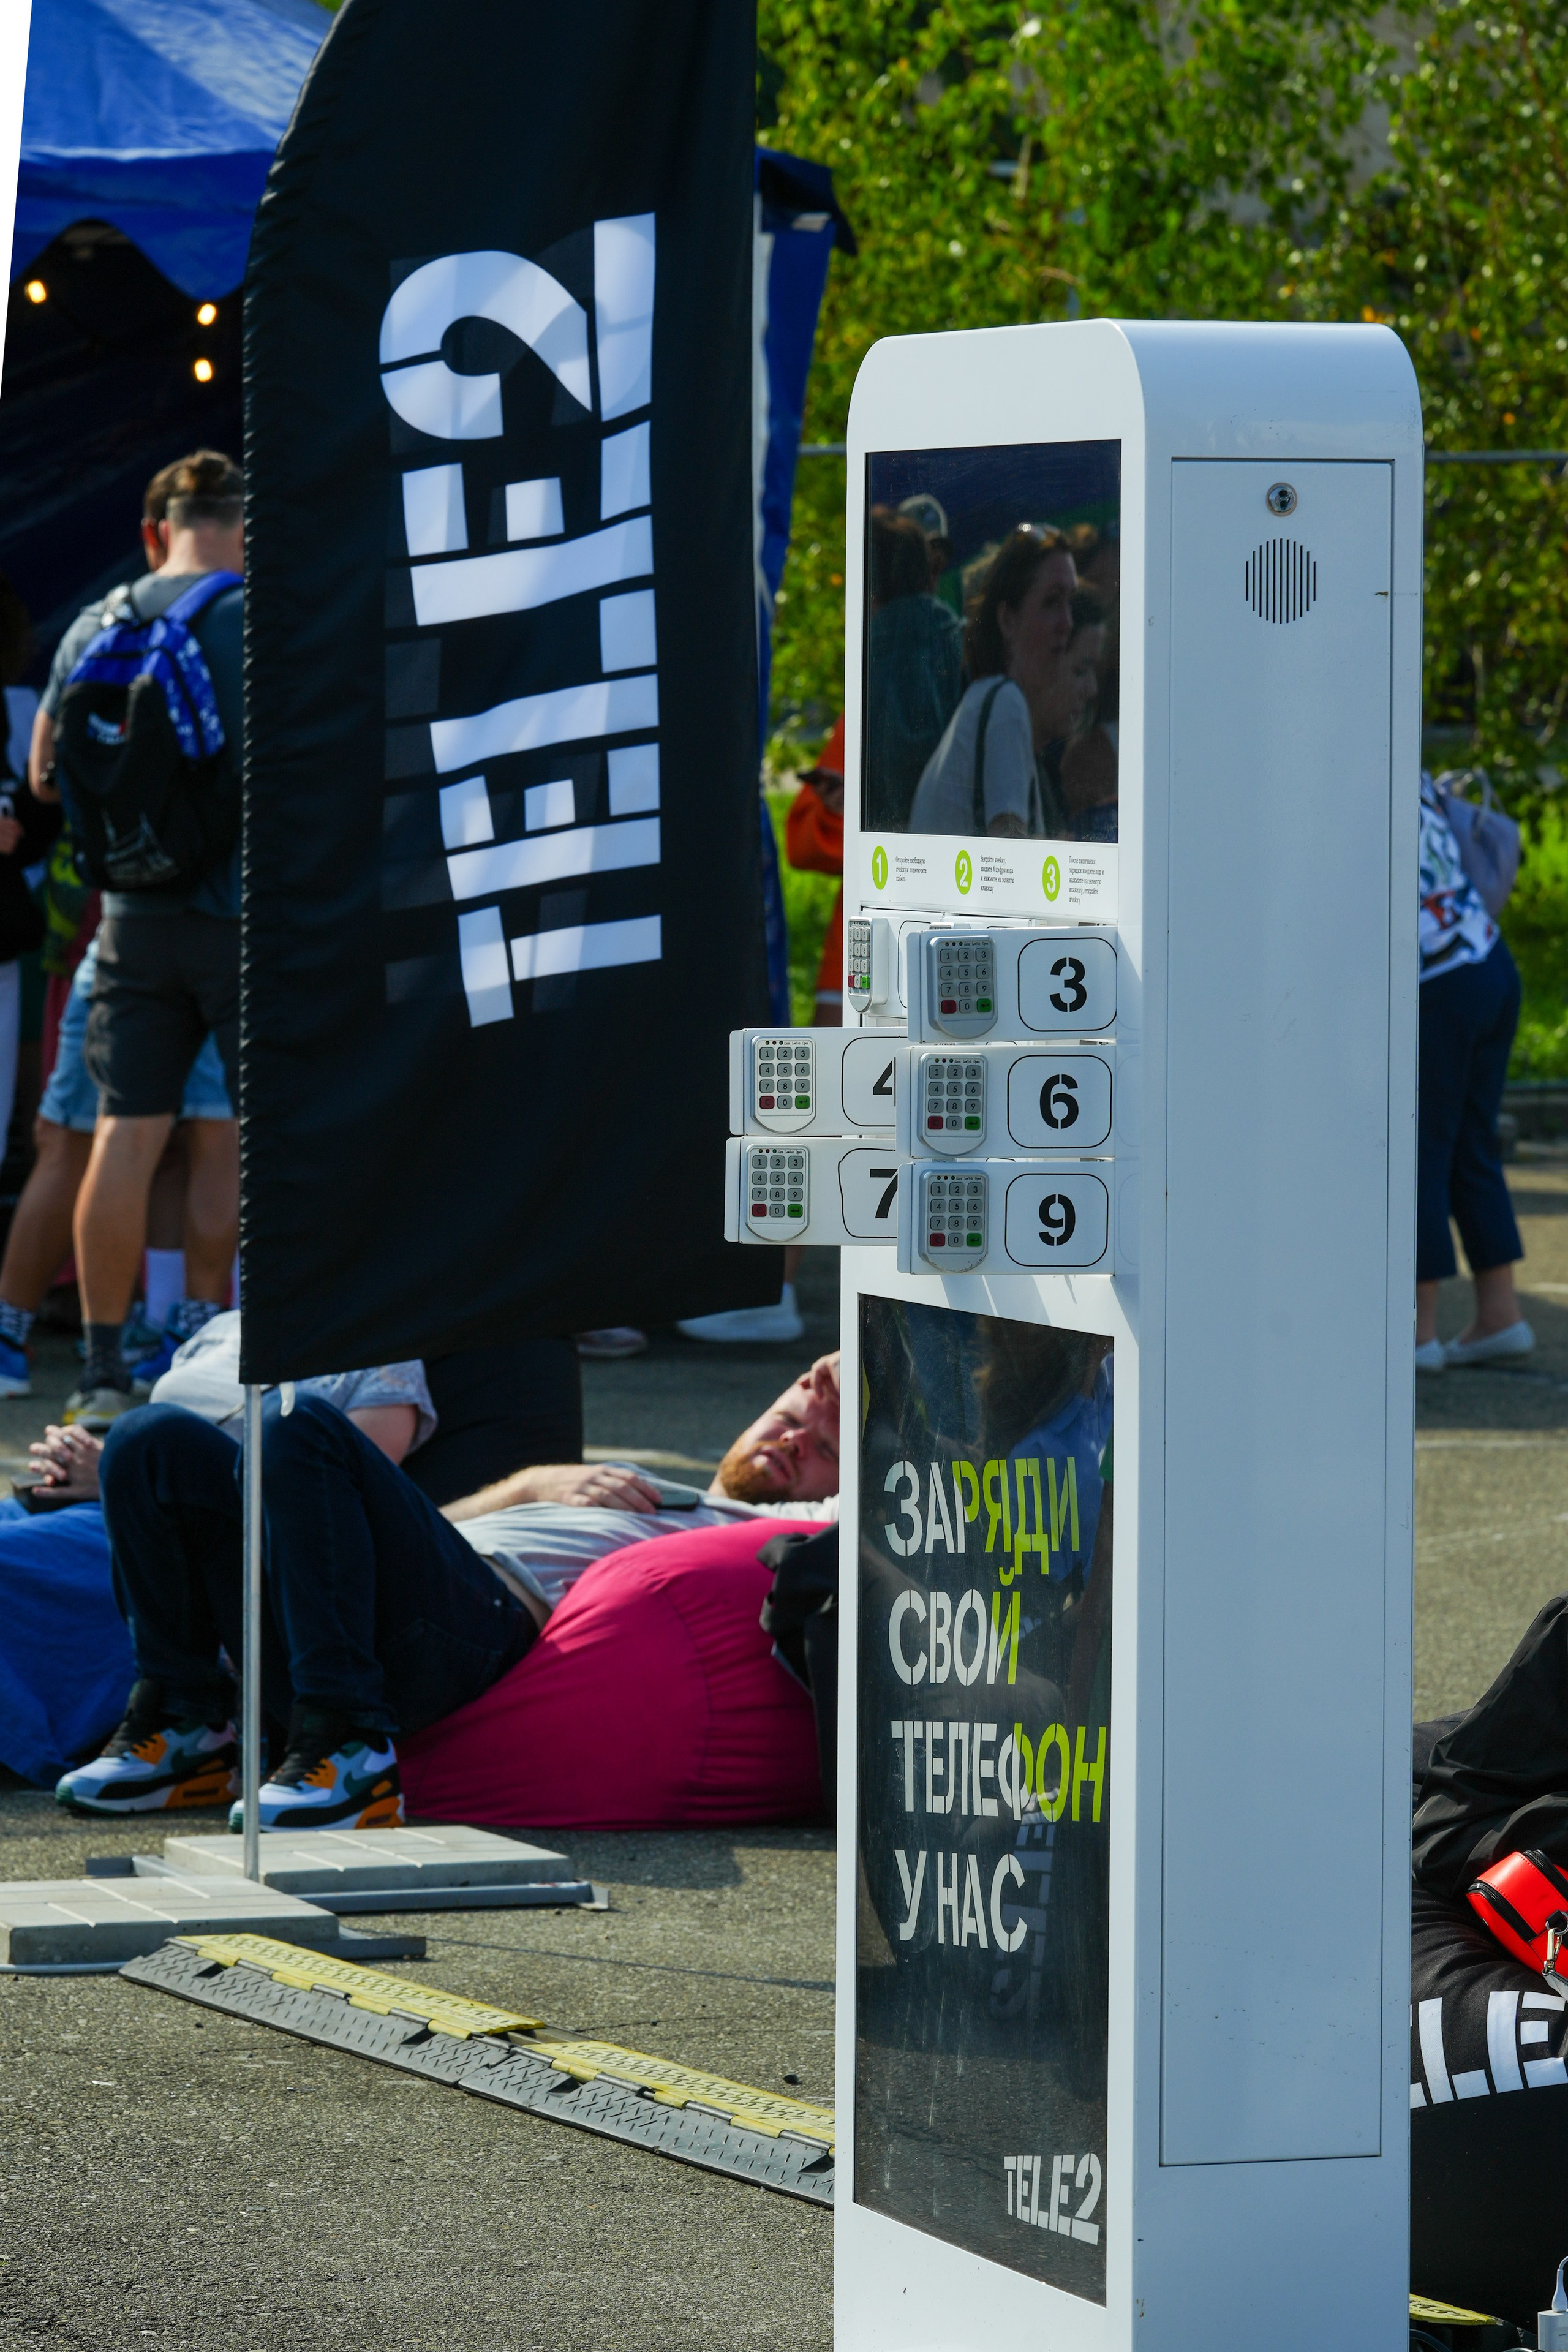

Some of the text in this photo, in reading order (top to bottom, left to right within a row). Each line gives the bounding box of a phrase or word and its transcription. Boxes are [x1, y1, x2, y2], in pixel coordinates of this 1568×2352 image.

[378, 211, 663, 1030] TELE2
[876, 854, 882, 882] 1
[896, 856, 909, 865] Откройте
[959, 858, 968, 887] 2
[981, 855, 994, 864] Закройте
[1047, 864, 1057, 894] 3
[1050, 957, 1087, 1012] 3
[873, 1057, 896, 1106] 4
[1039, 1074, 1079, 1129] 6
[870, 1169, 898, 1218] 7
[1038, 1194, 1076, 1246] 9
[884, 1457, 1079, 1575] ЗАРЯДИ
[888, 1567, 1021, 1686] СВОЙ
[891, 1721, 1107, 1823] ТЕЛЕФОН
[894, 1849, 1028, 1953] У НАС
[1004, 2152, 1102, 2245] TELE2
